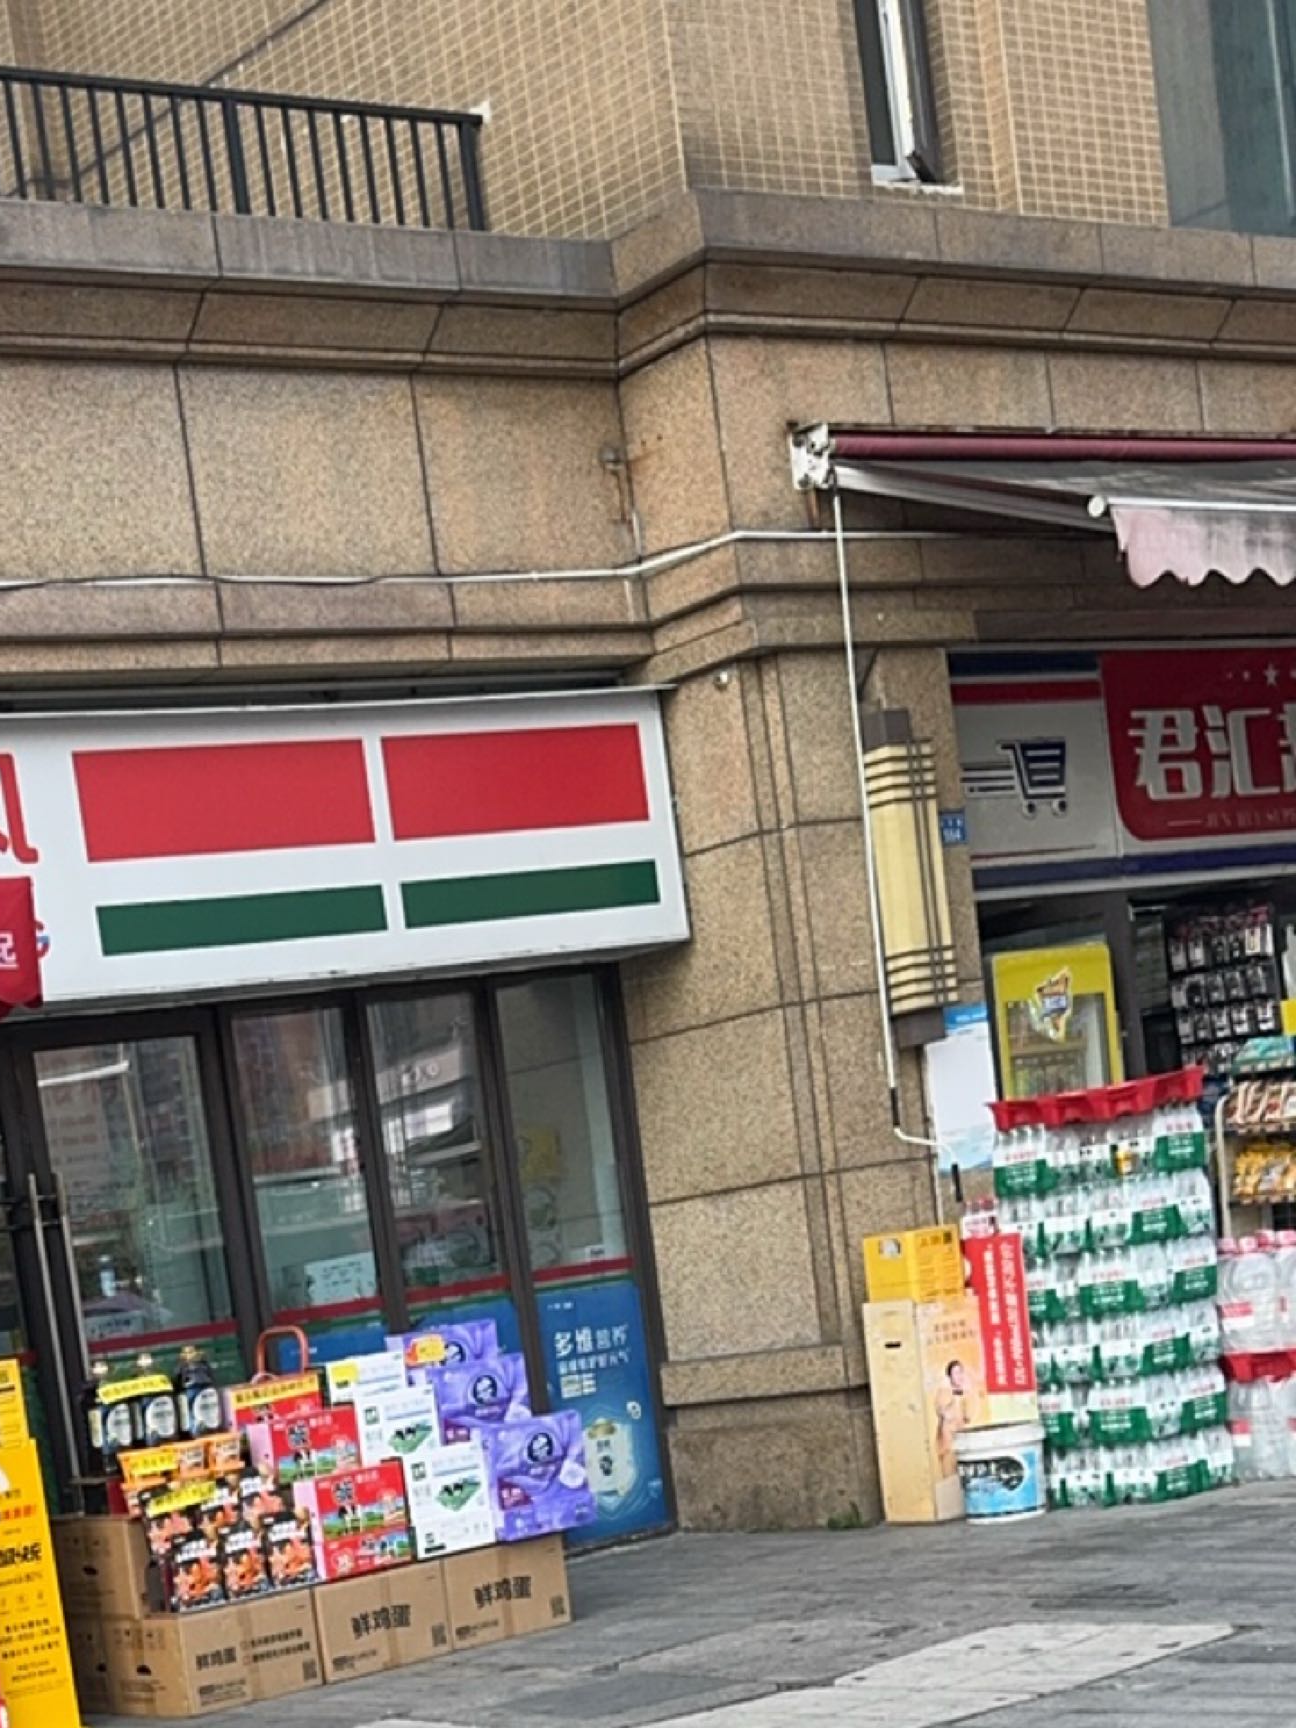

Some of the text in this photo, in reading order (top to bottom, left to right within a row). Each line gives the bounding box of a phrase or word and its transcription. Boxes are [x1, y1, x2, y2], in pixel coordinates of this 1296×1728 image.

[473, 1576, 532, 1610] 鲜鸡蛋
[351, 1604, 411, 1640] 鲜鸡蛋
